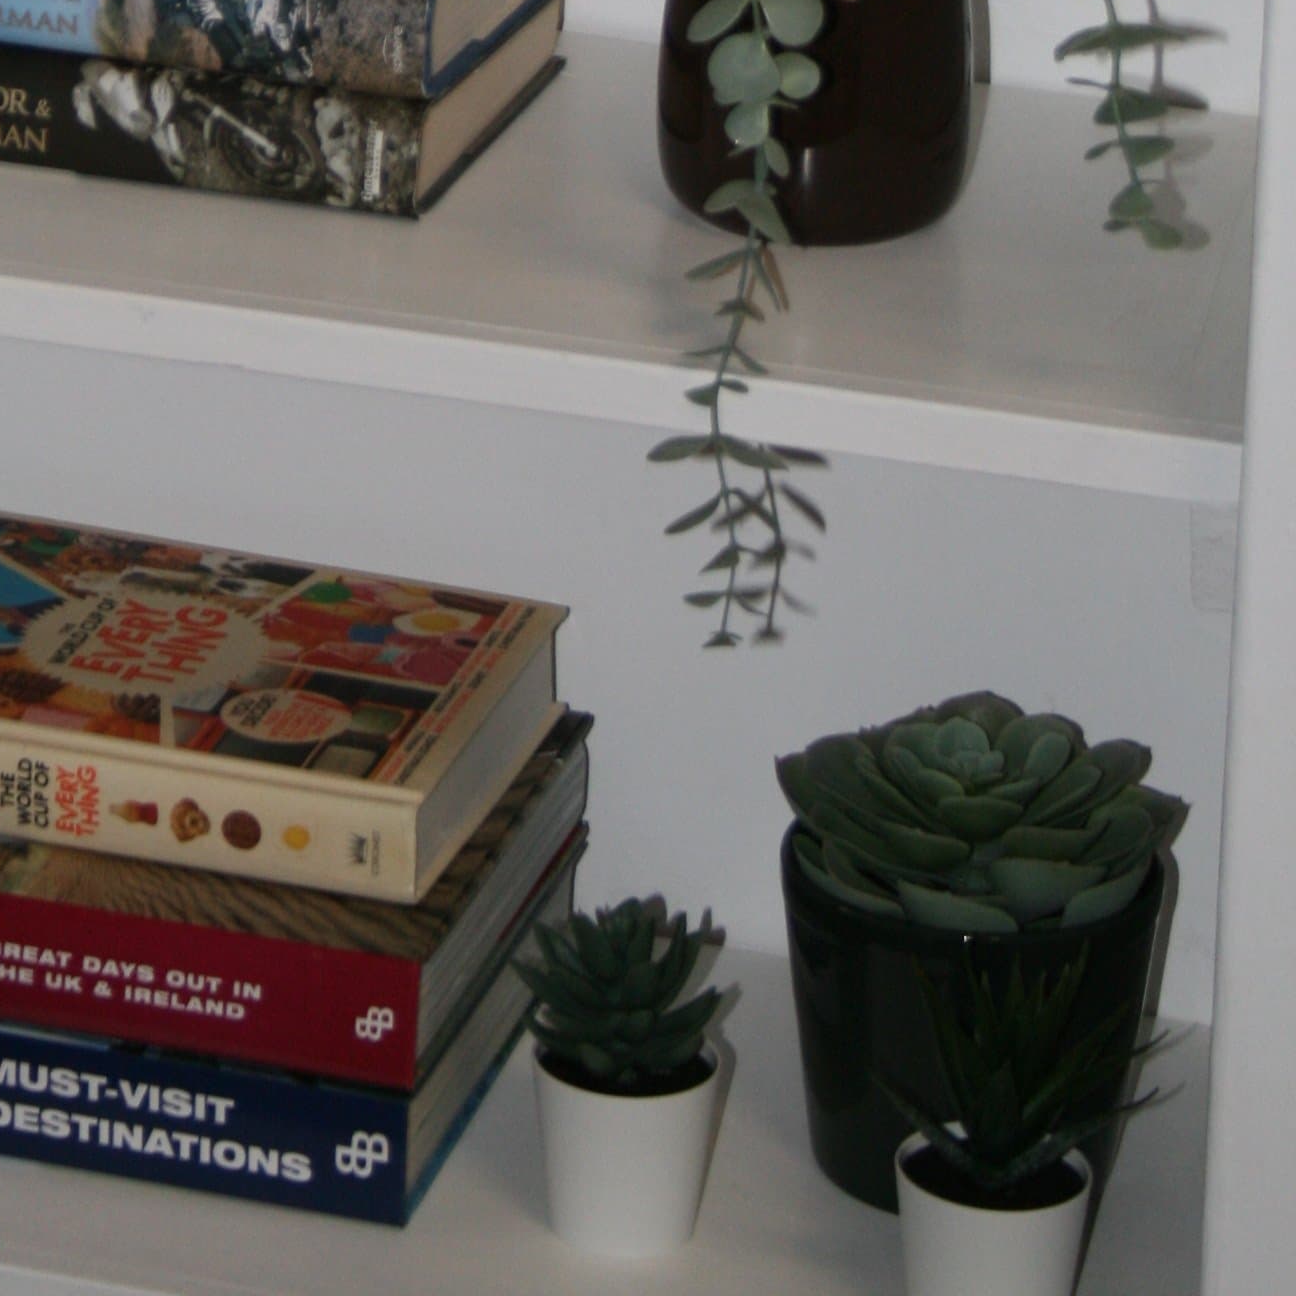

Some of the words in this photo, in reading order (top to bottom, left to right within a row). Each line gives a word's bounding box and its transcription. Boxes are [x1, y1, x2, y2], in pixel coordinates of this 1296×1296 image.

[36, 98, 52, 118] &
[70, 598, 174, 675] EVERY
[119, 605, 229, 684] THING
[0, 771, 16, 808] THE
[16, 757, 33, 825] WORLD
[34, 760, 50, 788] OF
[54, 764, 79, 832] EVERY
[33, 791, 49, 829] CUP
[74, 763, 101, 838] THING
[44, 971, 83, 994] UK
[93, 980, 113, 999] &
[124, 986, 246, 1021] IRELAND
[82, 955, 155, 984] DAYS
[166, 969, 223, 995] OUT
[232, 980, 262, 1001] IN
